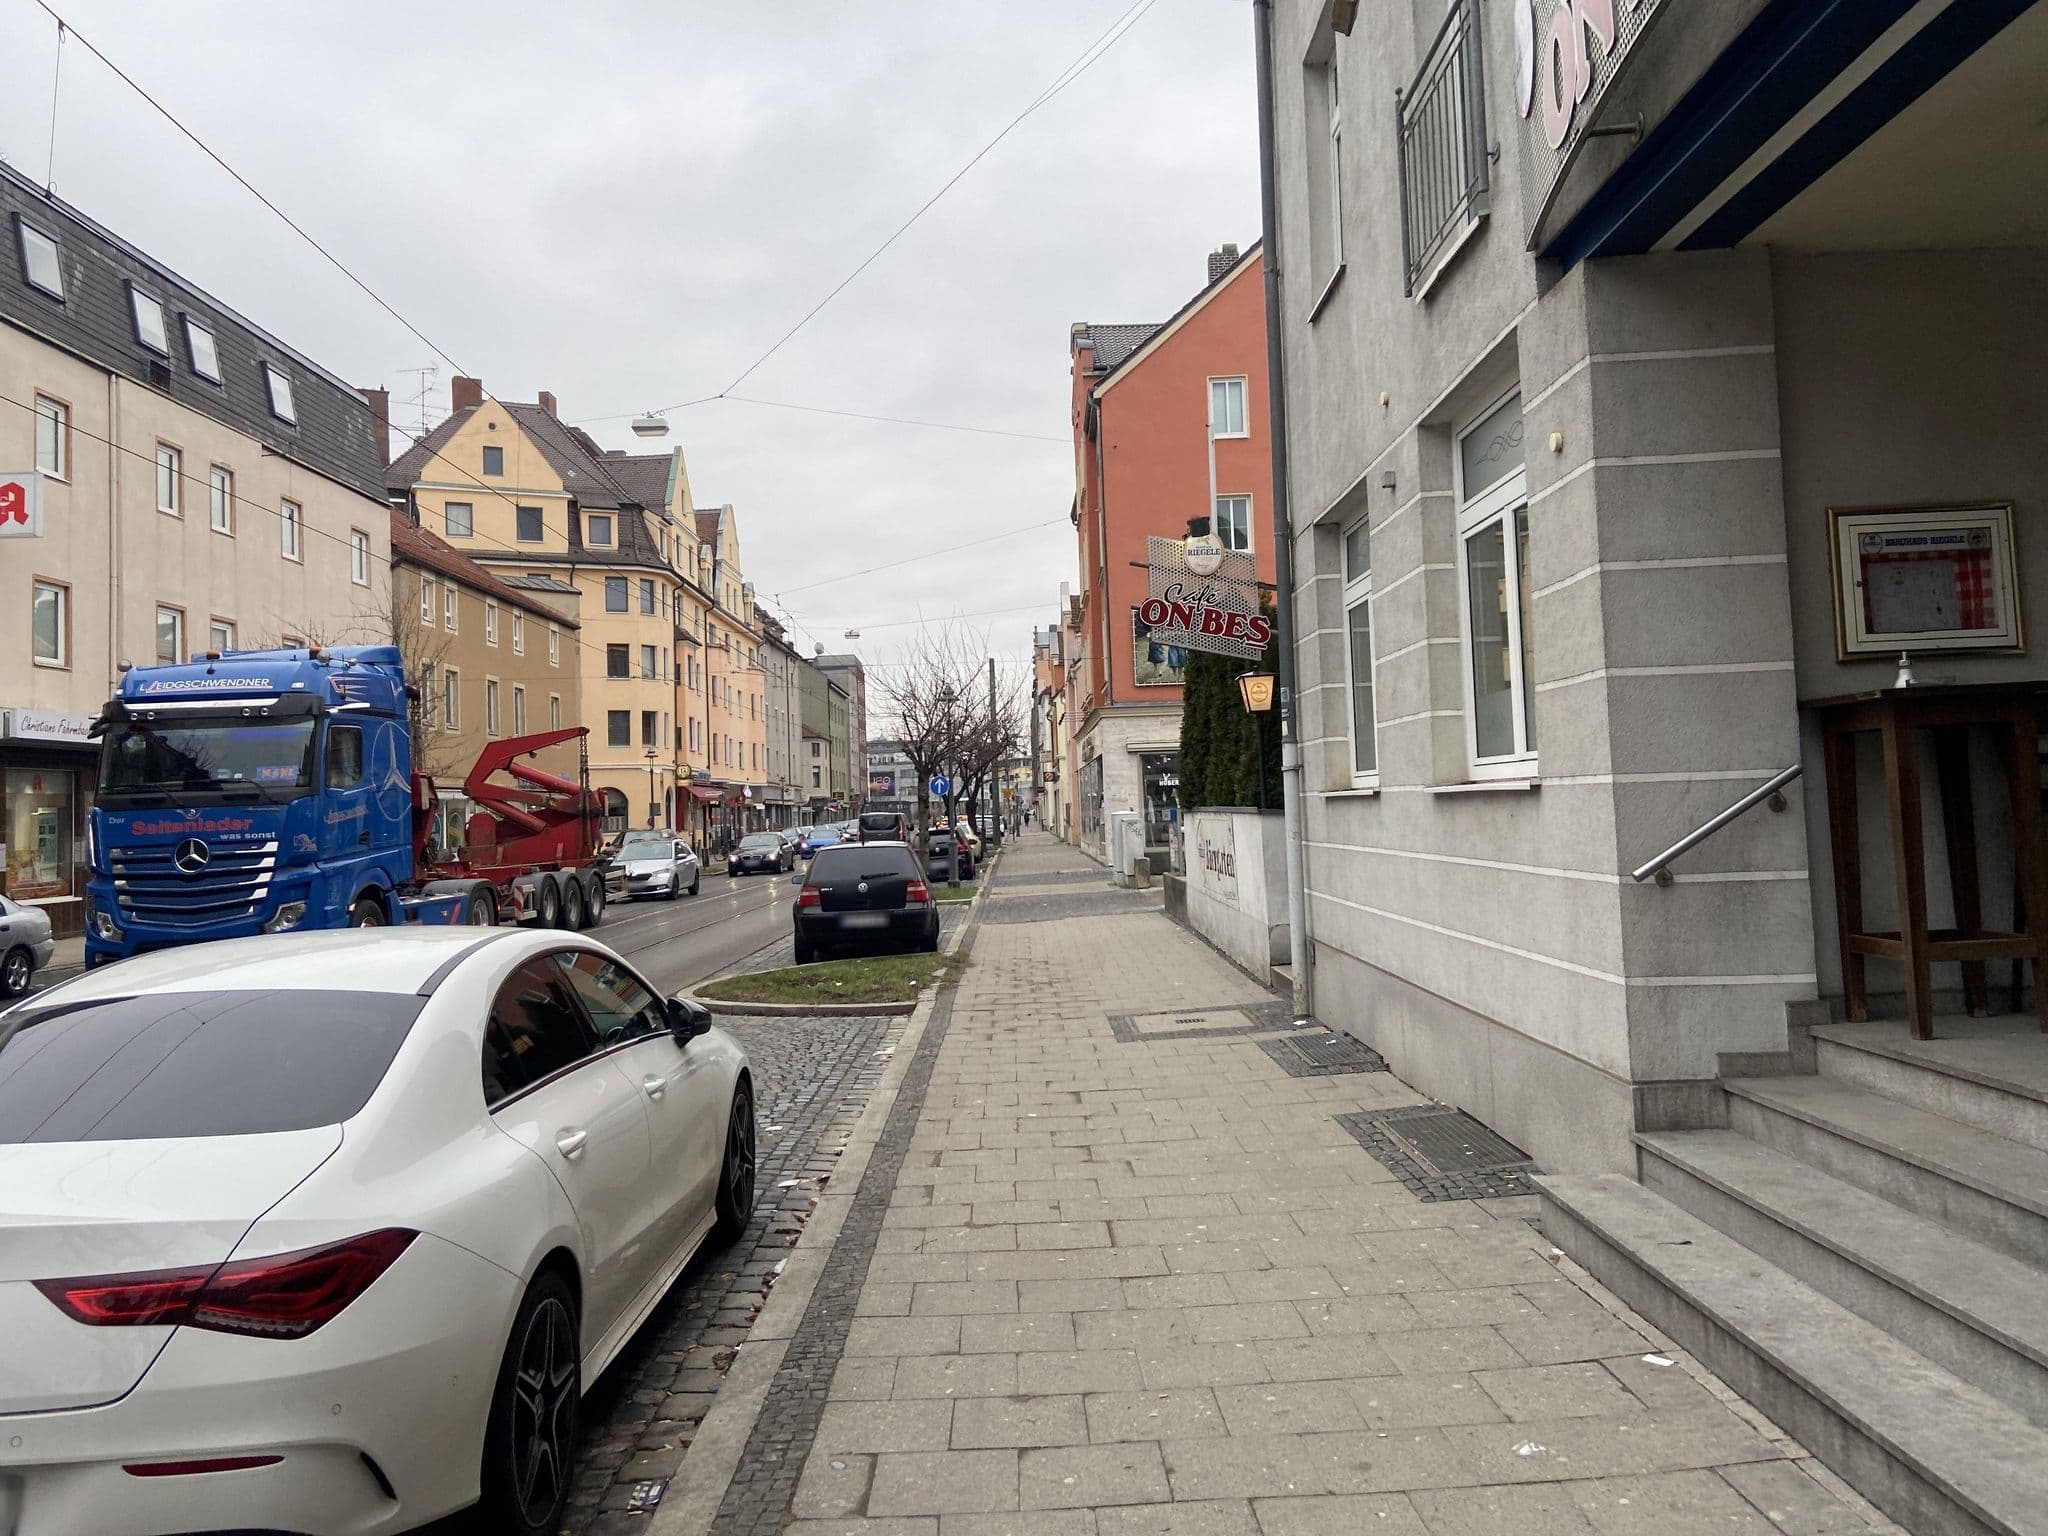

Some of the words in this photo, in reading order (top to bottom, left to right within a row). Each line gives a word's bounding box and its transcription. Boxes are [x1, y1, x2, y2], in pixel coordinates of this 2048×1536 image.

[1187, 548, 1221, 556] RIEGELE
[1164, 582, 1220, 611] Café
[1139, 597, 1195, 632] ON
[1198, 607, 1272, 650] BES
[132, 816, 254, 835] Seitenlader
[244, 832, 276, 840] sonst
